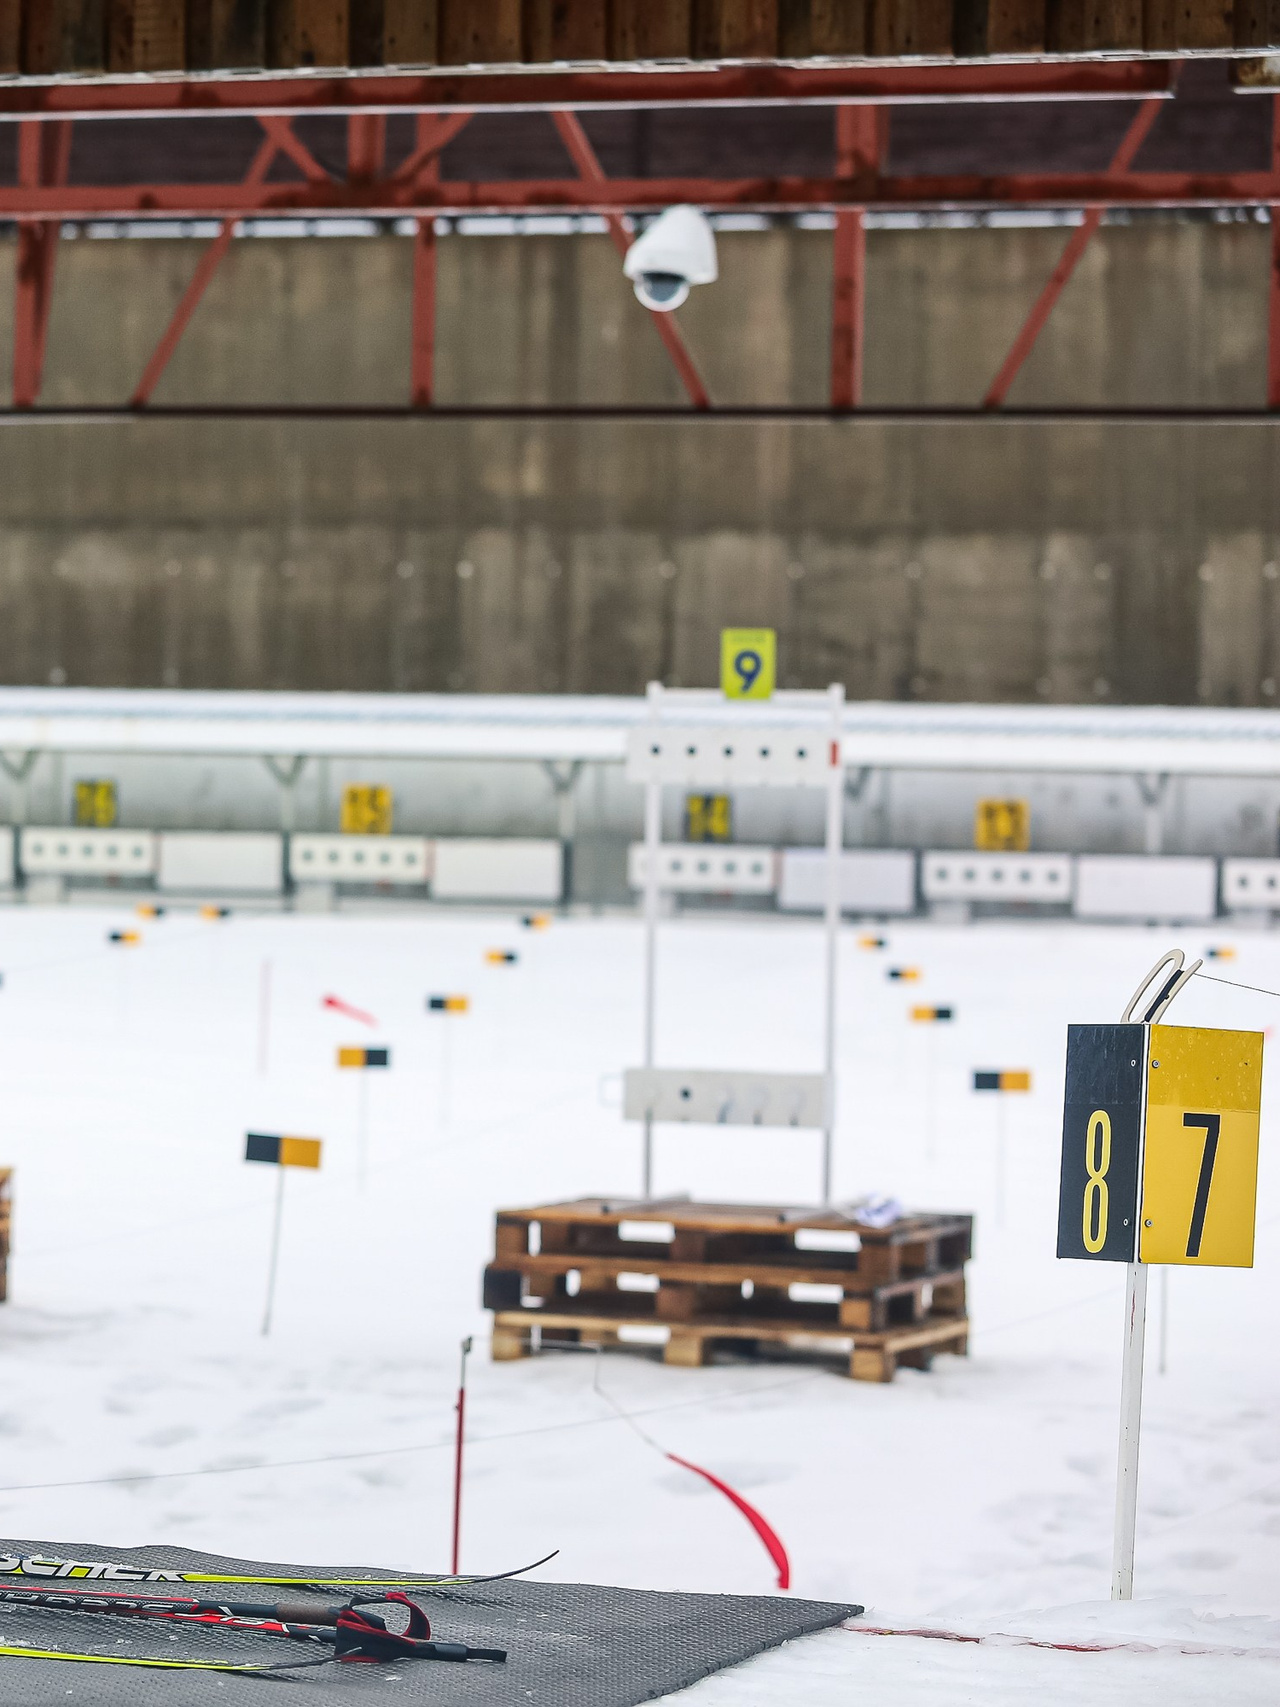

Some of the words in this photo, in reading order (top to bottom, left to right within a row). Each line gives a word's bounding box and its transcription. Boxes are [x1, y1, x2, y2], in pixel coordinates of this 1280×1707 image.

[733, 649, 762, 693] 9
[1082, 1109, 1112, 1253] 8
[1183, 1112, 1221, 1258] 7
